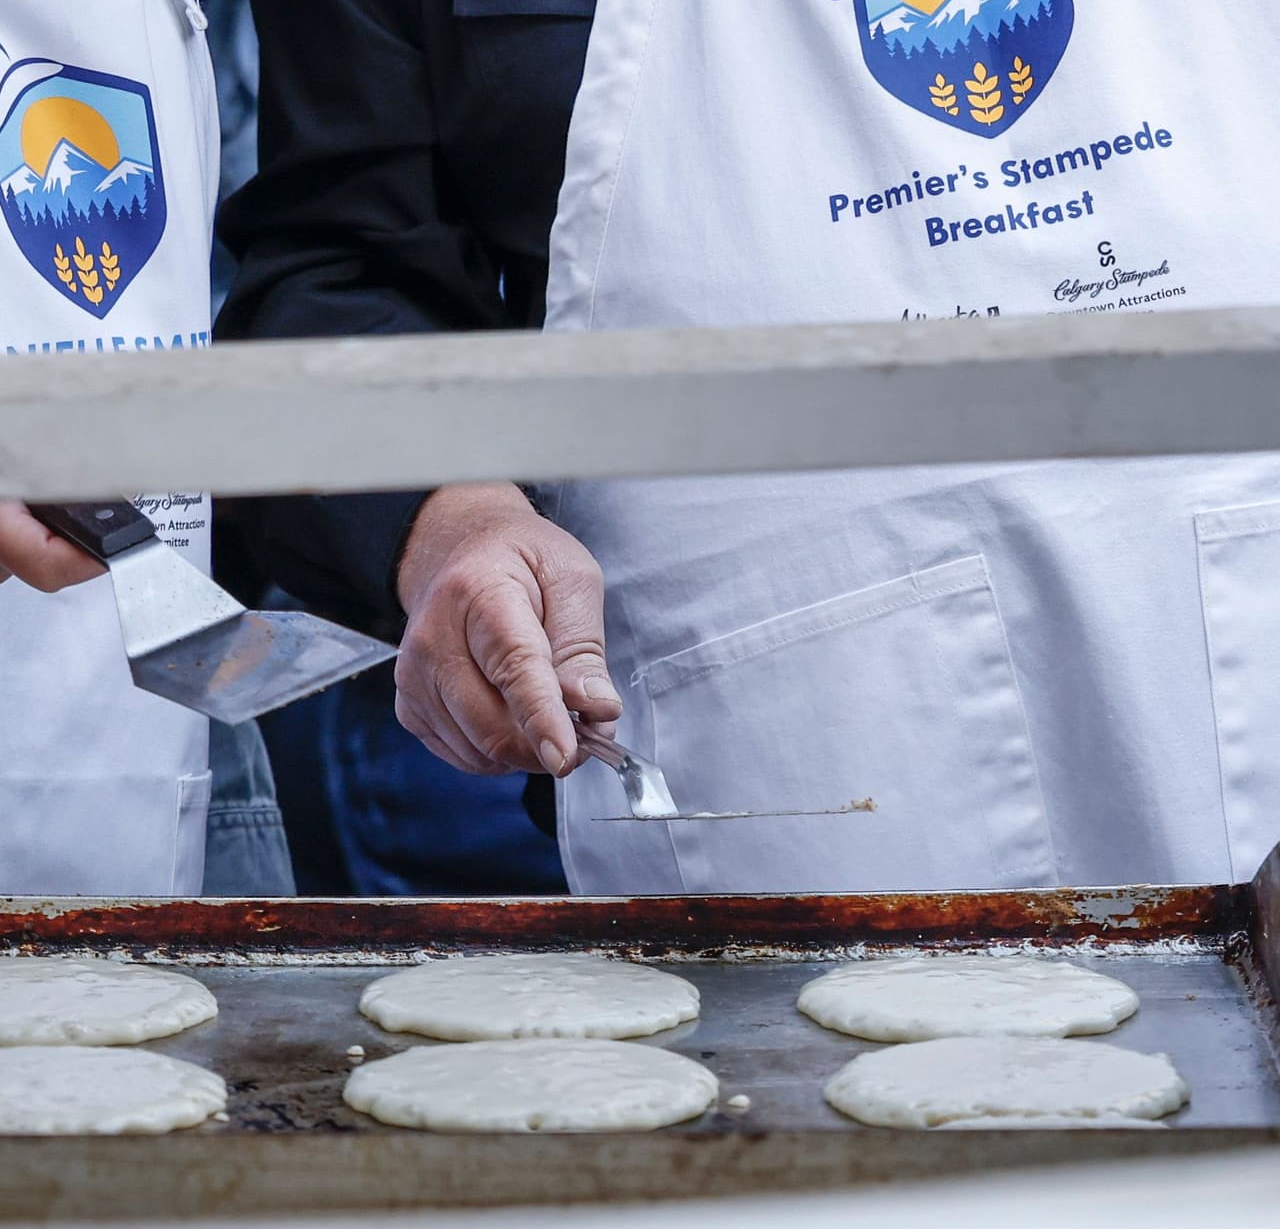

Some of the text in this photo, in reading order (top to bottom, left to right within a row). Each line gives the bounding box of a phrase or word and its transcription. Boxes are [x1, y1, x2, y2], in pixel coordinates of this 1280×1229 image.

[829, 121, 1173, 222] Premier’s Stampede
[925, 190, 1094, 247] Breakfast
[1053, 259, 1170, 303] Calgary Stampede
[1118, 286, 1186, 308] Attractions
